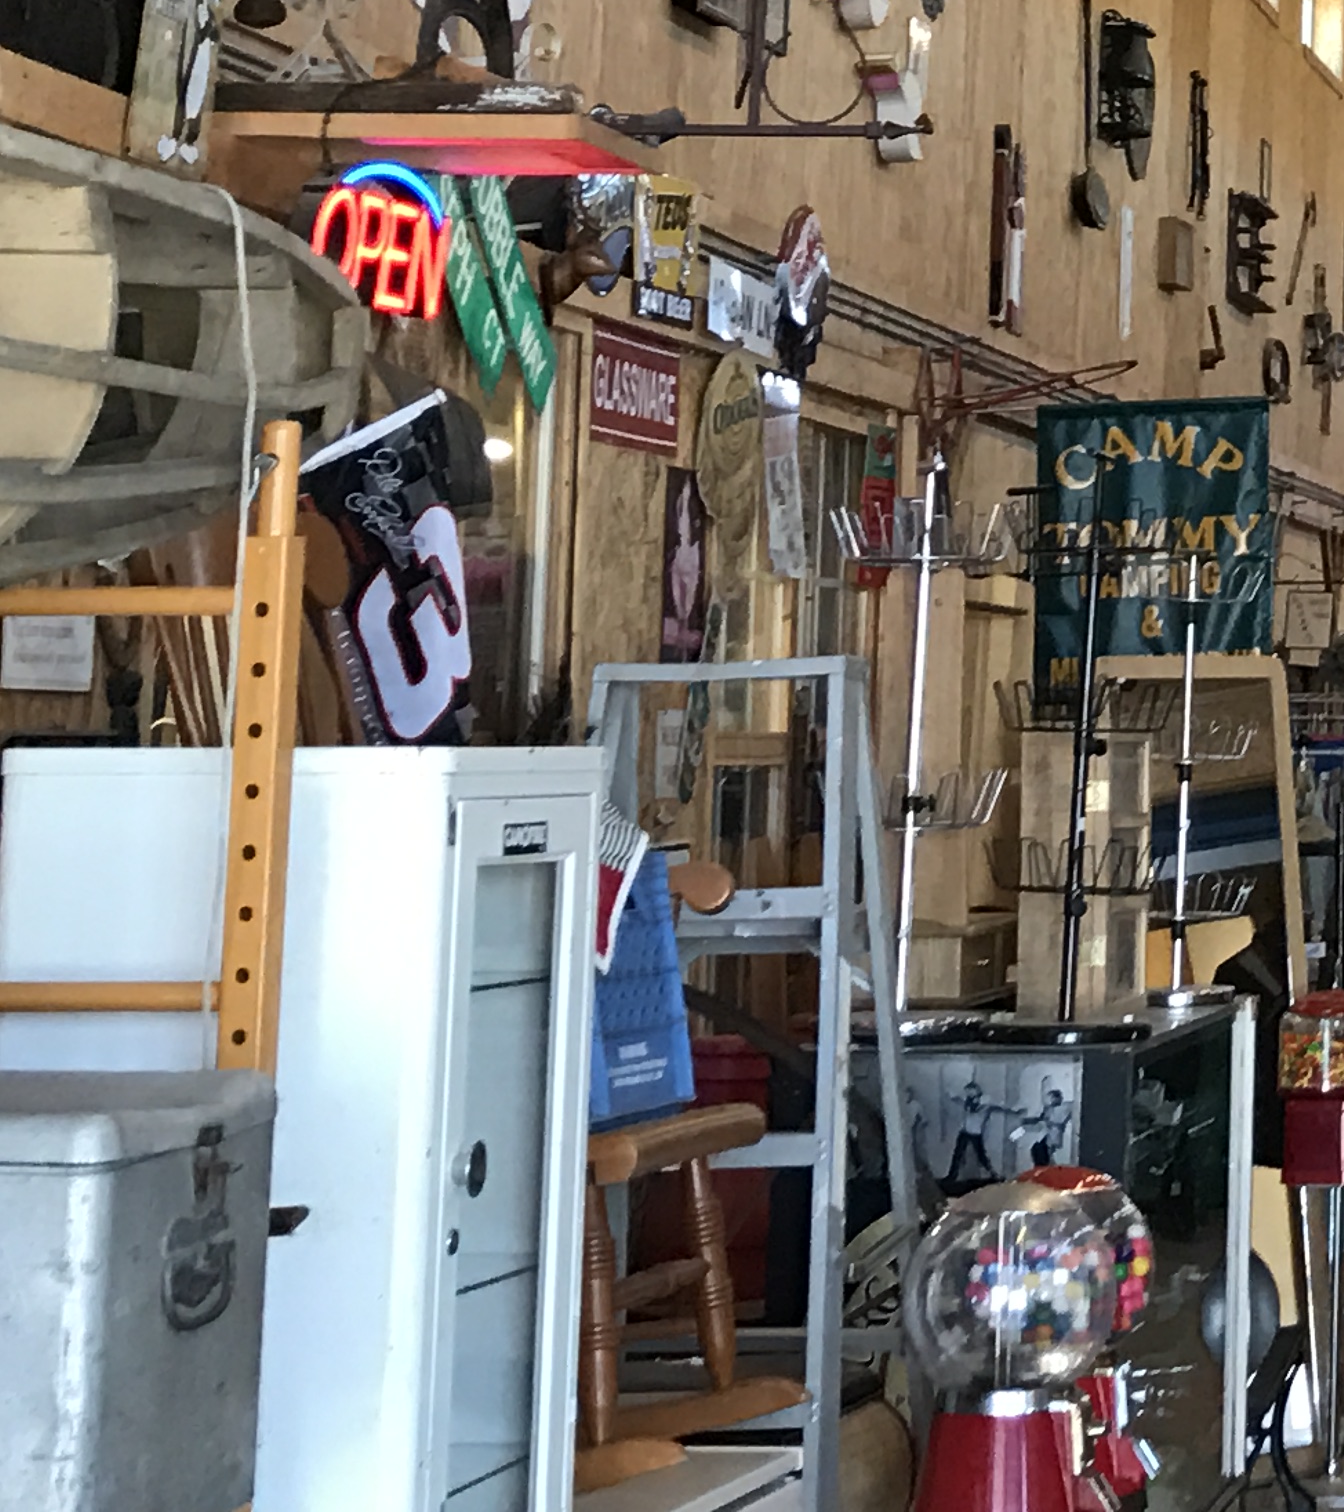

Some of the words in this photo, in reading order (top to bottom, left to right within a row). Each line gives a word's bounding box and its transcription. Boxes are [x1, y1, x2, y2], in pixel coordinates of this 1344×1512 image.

[310, 185, 453, 322] OPEN
[593, 353, 677, 426] GLASSWARE
[1054, 420, 1244, 490] CAMP
[1042, 512, 1261, 563] TOMMY
[352, 504, 472, 740] 3
[1140, 604, 1164, 639] &
